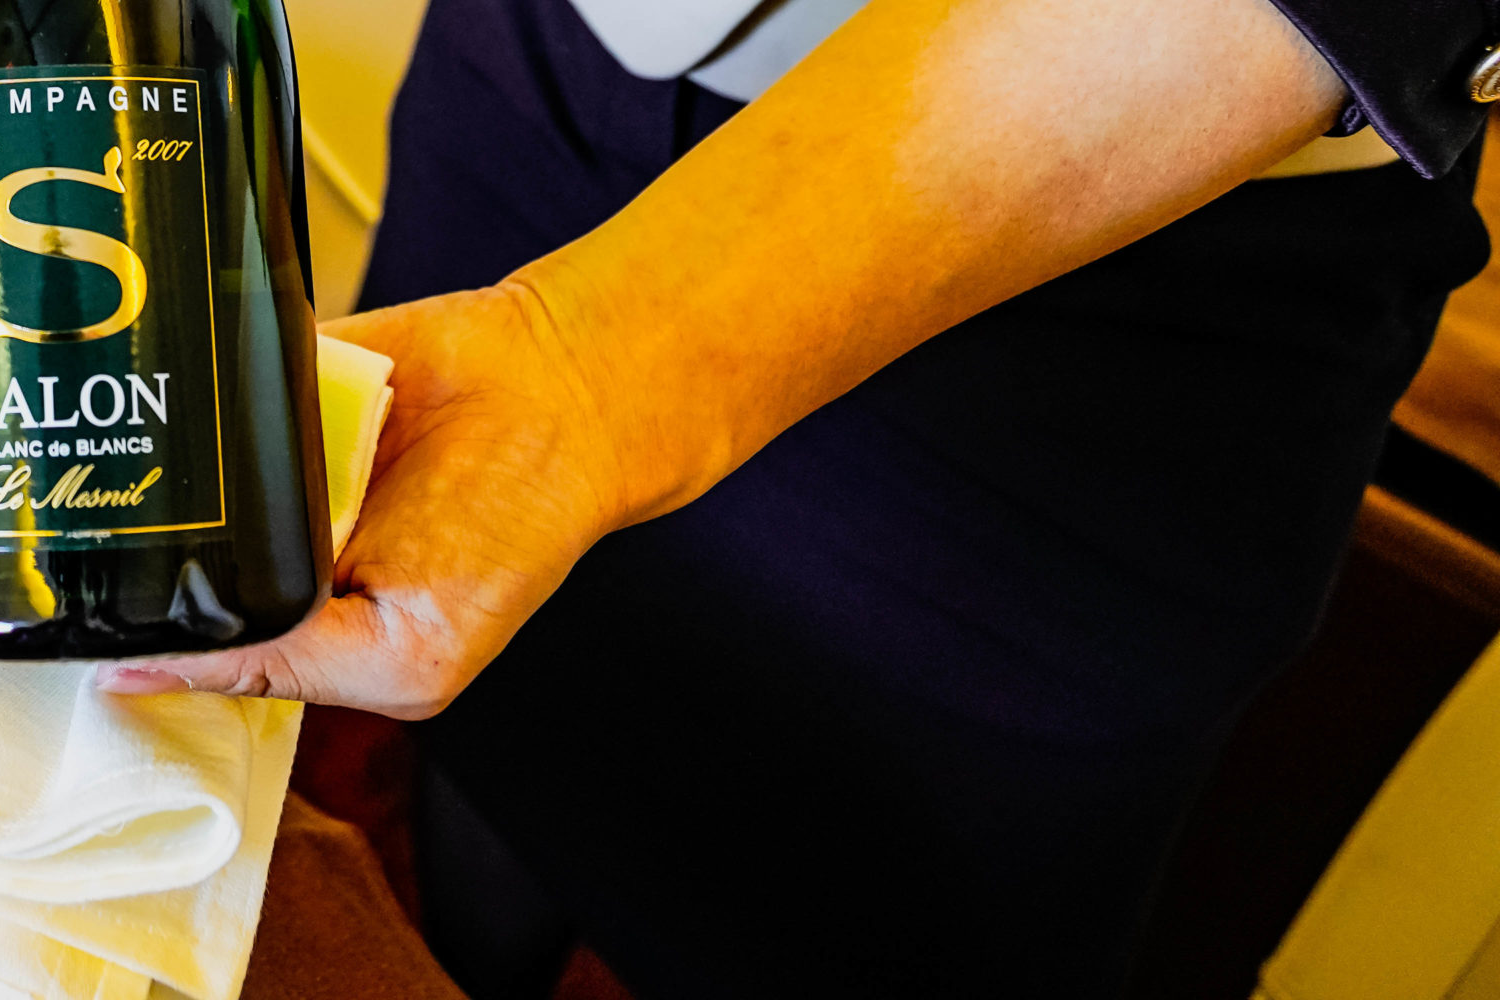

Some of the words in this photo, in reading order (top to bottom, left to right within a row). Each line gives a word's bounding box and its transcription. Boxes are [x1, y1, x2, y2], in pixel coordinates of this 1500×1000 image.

[132, 139, 193, 162] 2007
[47, 440, 71, 458] de
[75, 436, 154, 457] BLANCS
[30, 463, 163, 510] Mesnil
